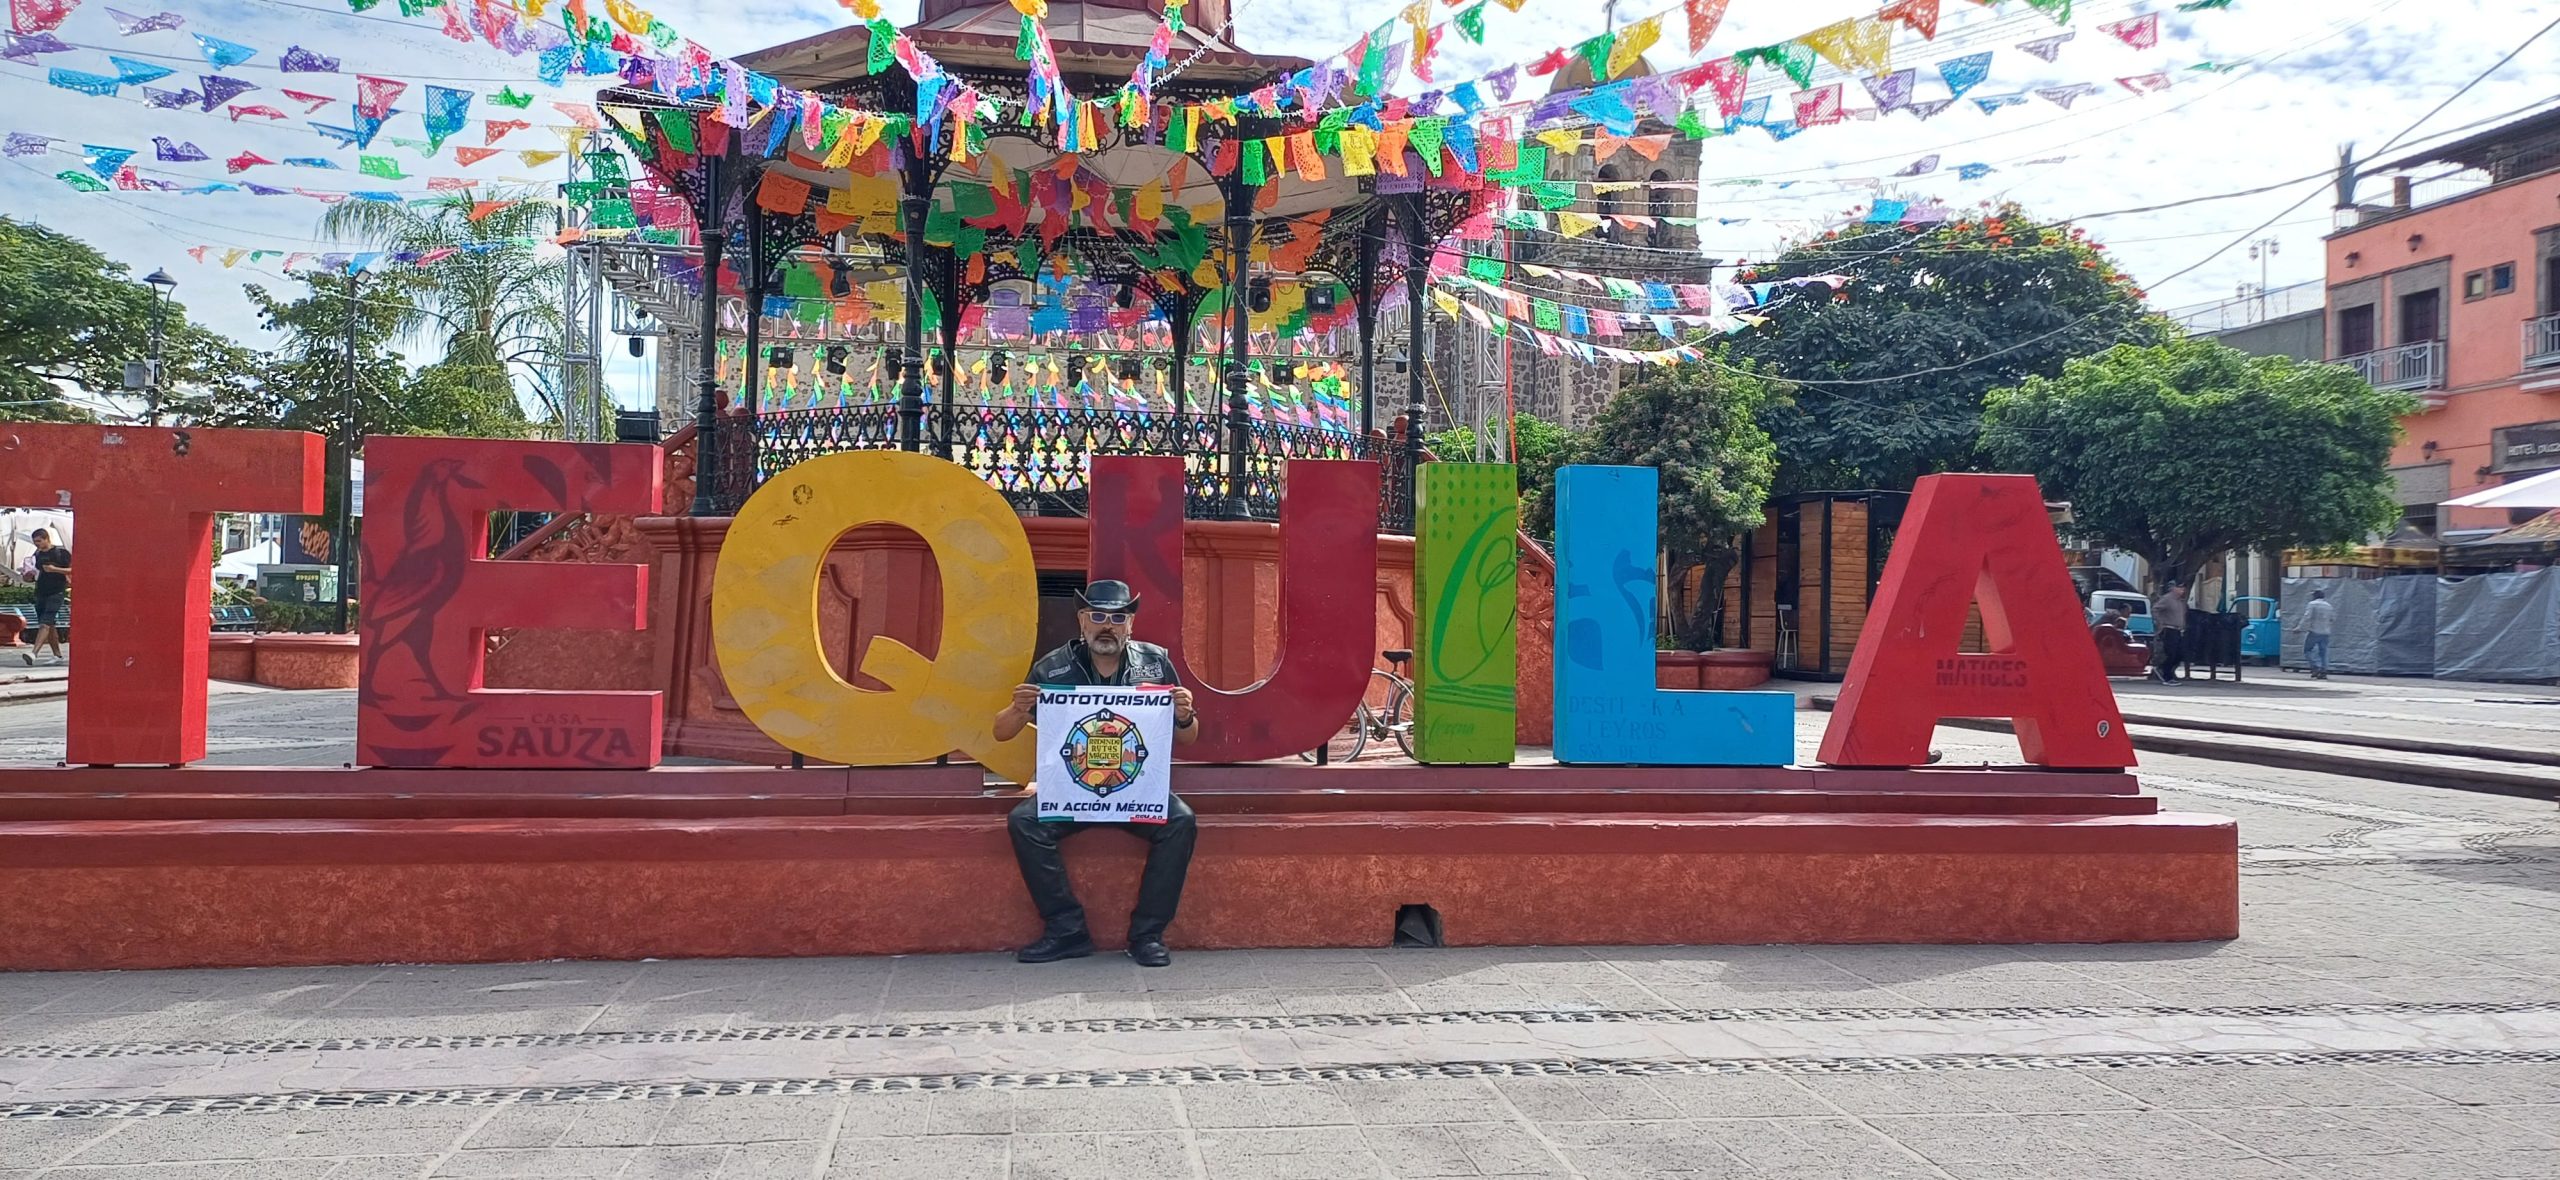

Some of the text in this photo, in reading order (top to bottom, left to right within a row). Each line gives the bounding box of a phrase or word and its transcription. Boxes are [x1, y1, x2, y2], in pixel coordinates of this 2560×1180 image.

[0, 427, 2137, 785] TEQUILA
[1936, 659, 2029, 687] MATICES
[1039, 692, 1172, 706] MOTOTURISMO
[531, 713, 582, 725] CASA
[477, 725, 636, 764] SAUZA
[1041, 799, 1164, 813] EN ACCIÓN MÉXICO
